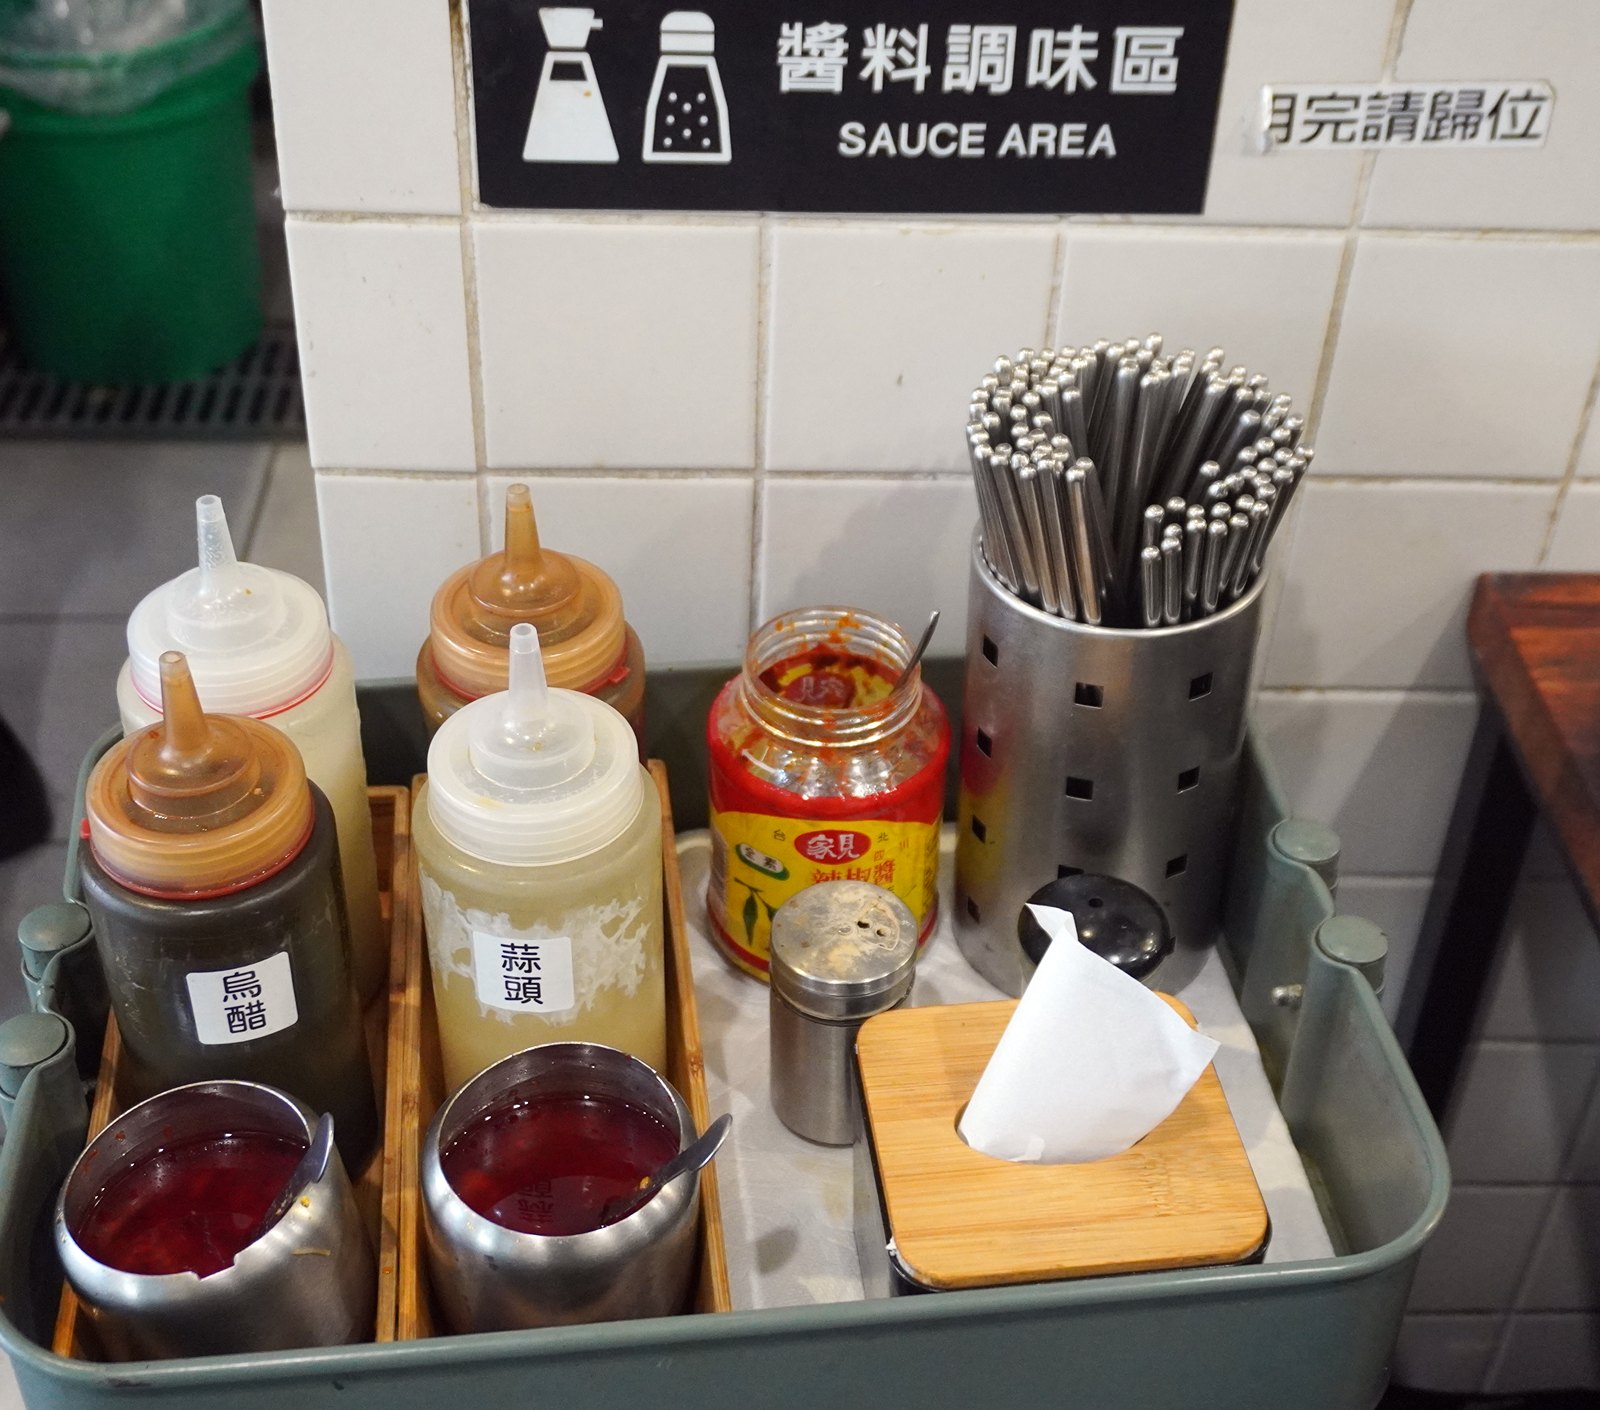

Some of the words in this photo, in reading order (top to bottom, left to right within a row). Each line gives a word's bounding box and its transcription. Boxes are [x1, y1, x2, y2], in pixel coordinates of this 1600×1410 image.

[776, 22, 1185, 96] 醬料調味區
[838, 121, 986, 159] SAUCE
[998, 121, 1118, 158] AREA
[222, 971, 267, 1035] 烏醋
[500, 942, 544, 1005] 蒜頭
